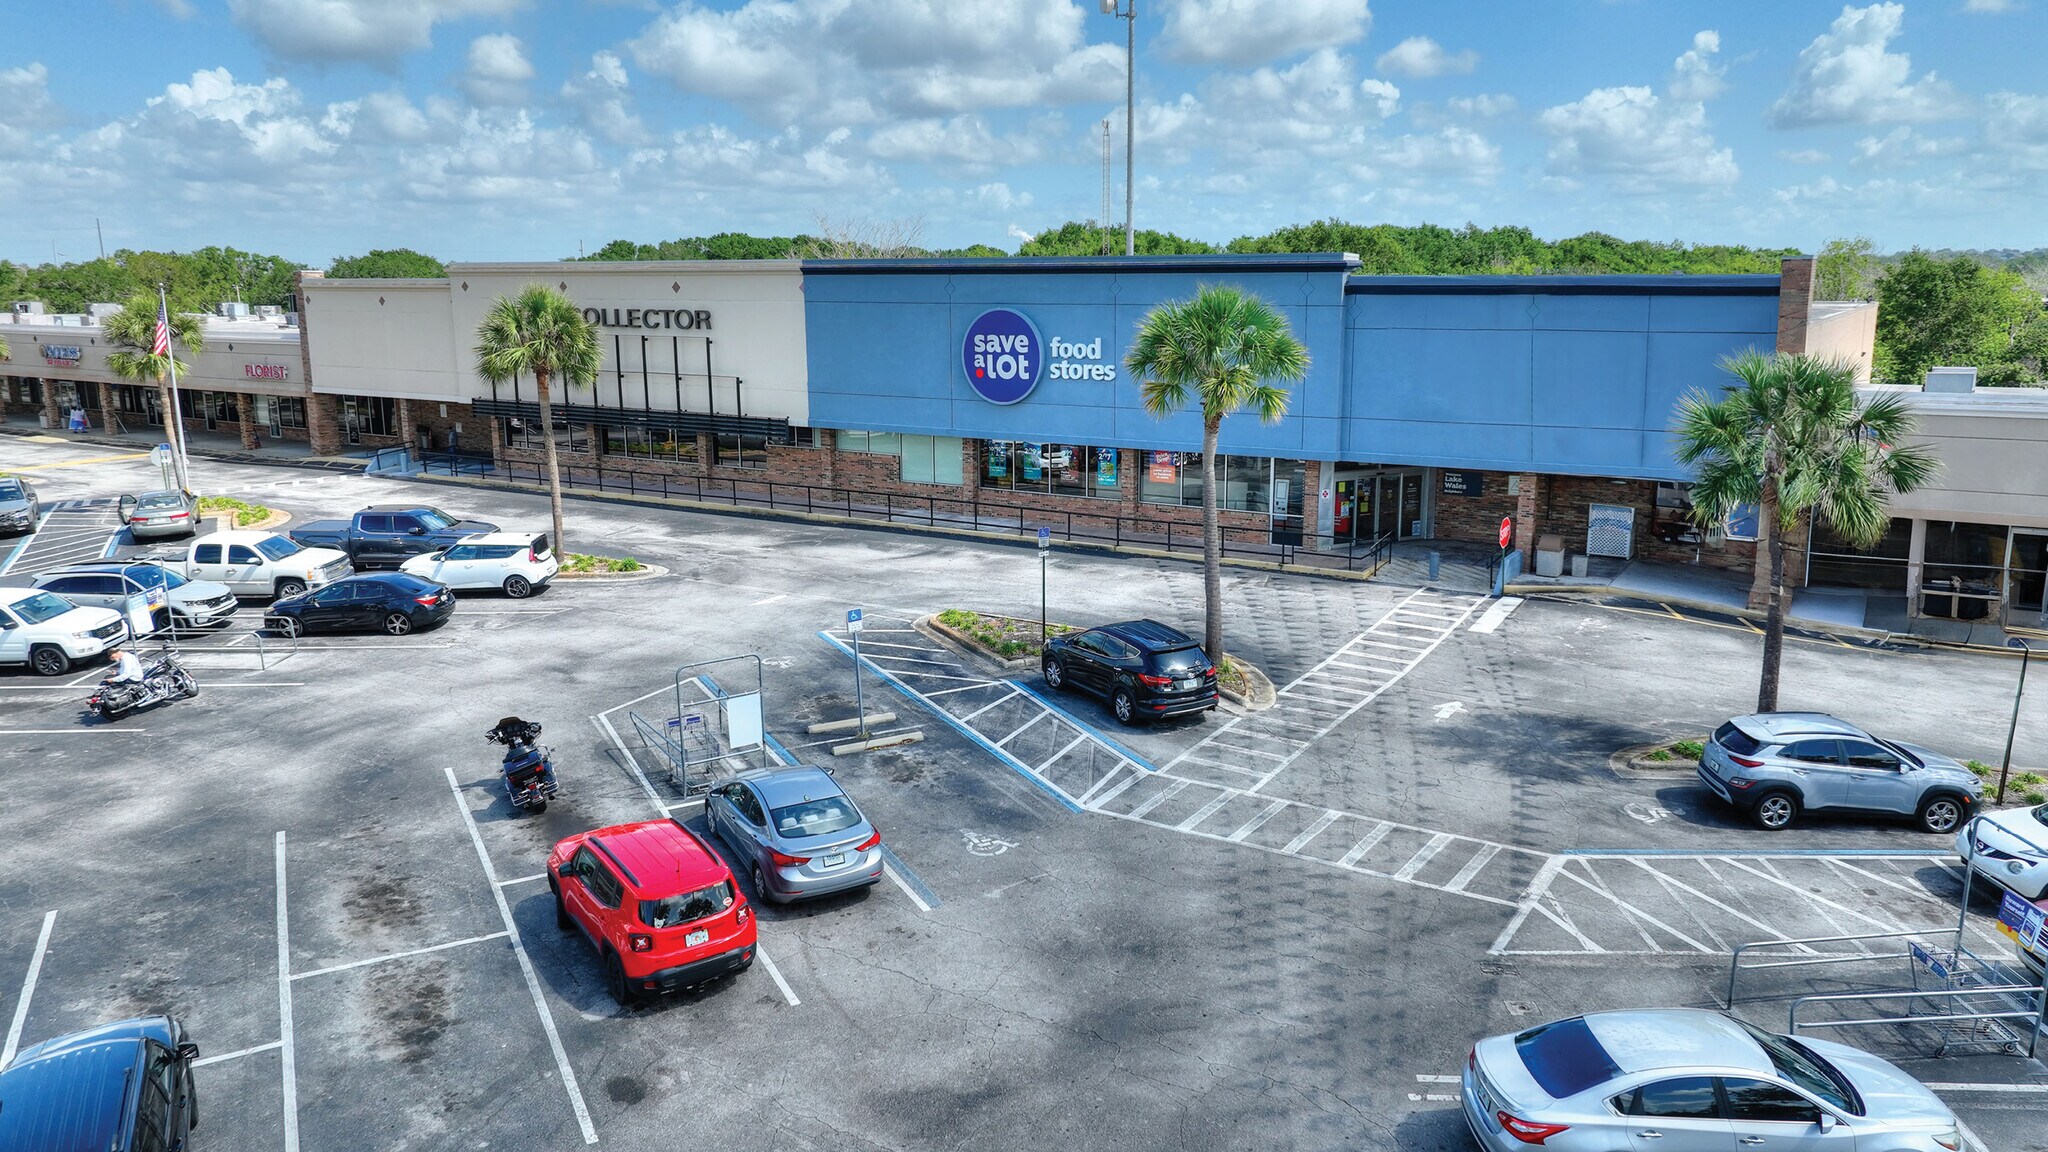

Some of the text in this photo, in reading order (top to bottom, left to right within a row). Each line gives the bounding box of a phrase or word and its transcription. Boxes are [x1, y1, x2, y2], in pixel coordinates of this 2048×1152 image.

[575, 307, 712, 330] OLLECTOR
[974, 334, 1029, 353] save
[1050, 336, 1102, 360] food
[245, 364, 288, 380] FLORIST
[1050, 360, 1117, 381] stores
[1444, 482, 1467, 490] Wales
[2005, 894, 2025, 911] Reward
